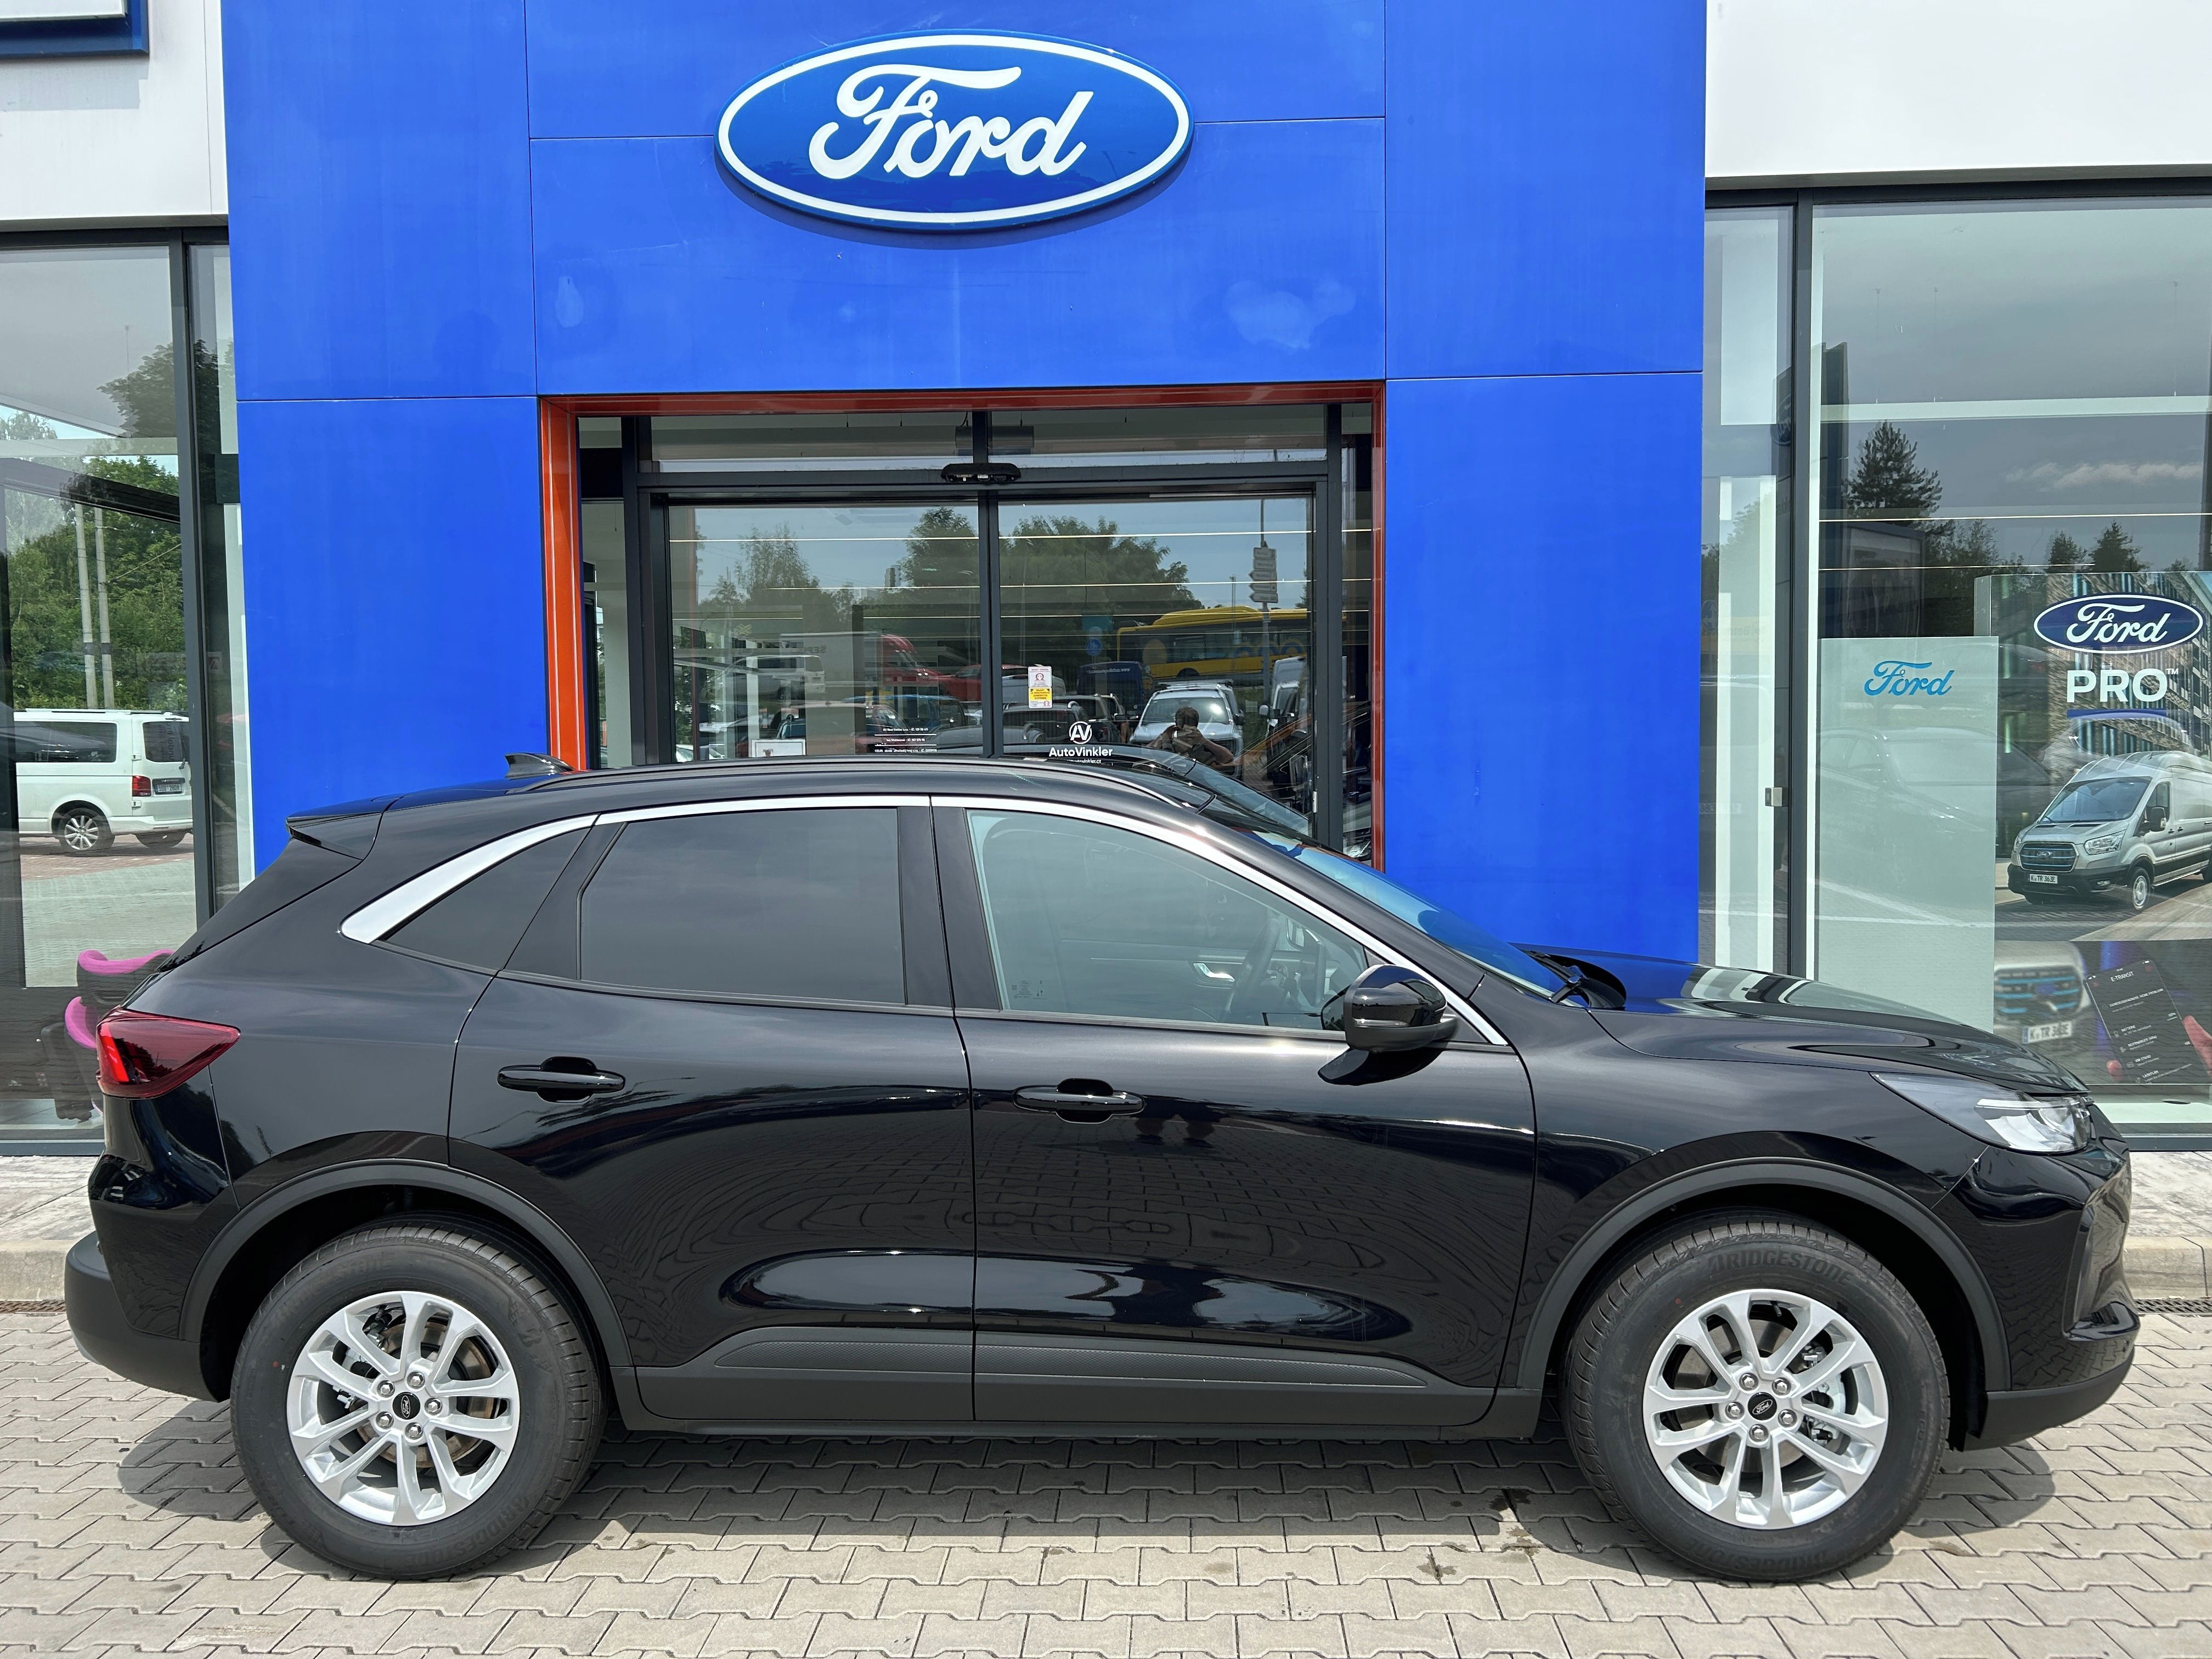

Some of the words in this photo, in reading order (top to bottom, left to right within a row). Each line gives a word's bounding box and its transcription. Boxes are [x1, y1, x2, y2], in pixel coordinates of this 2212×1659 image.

[809, 64, 1094, 179] Ford
[2067, 603, 2171, 642] Ford
[1864, 661, 1955, 696] Ford
[2067, 668, 2168, 702] PRO
[1048, 746, 1113, 757] AutoVinkler
[2111, 971, 2134, 982] E-TRANSIT
[1708, 1249, 1854, 1287] BRIDGESTONE
[1756, 1401, 1770, 1413] Ford
